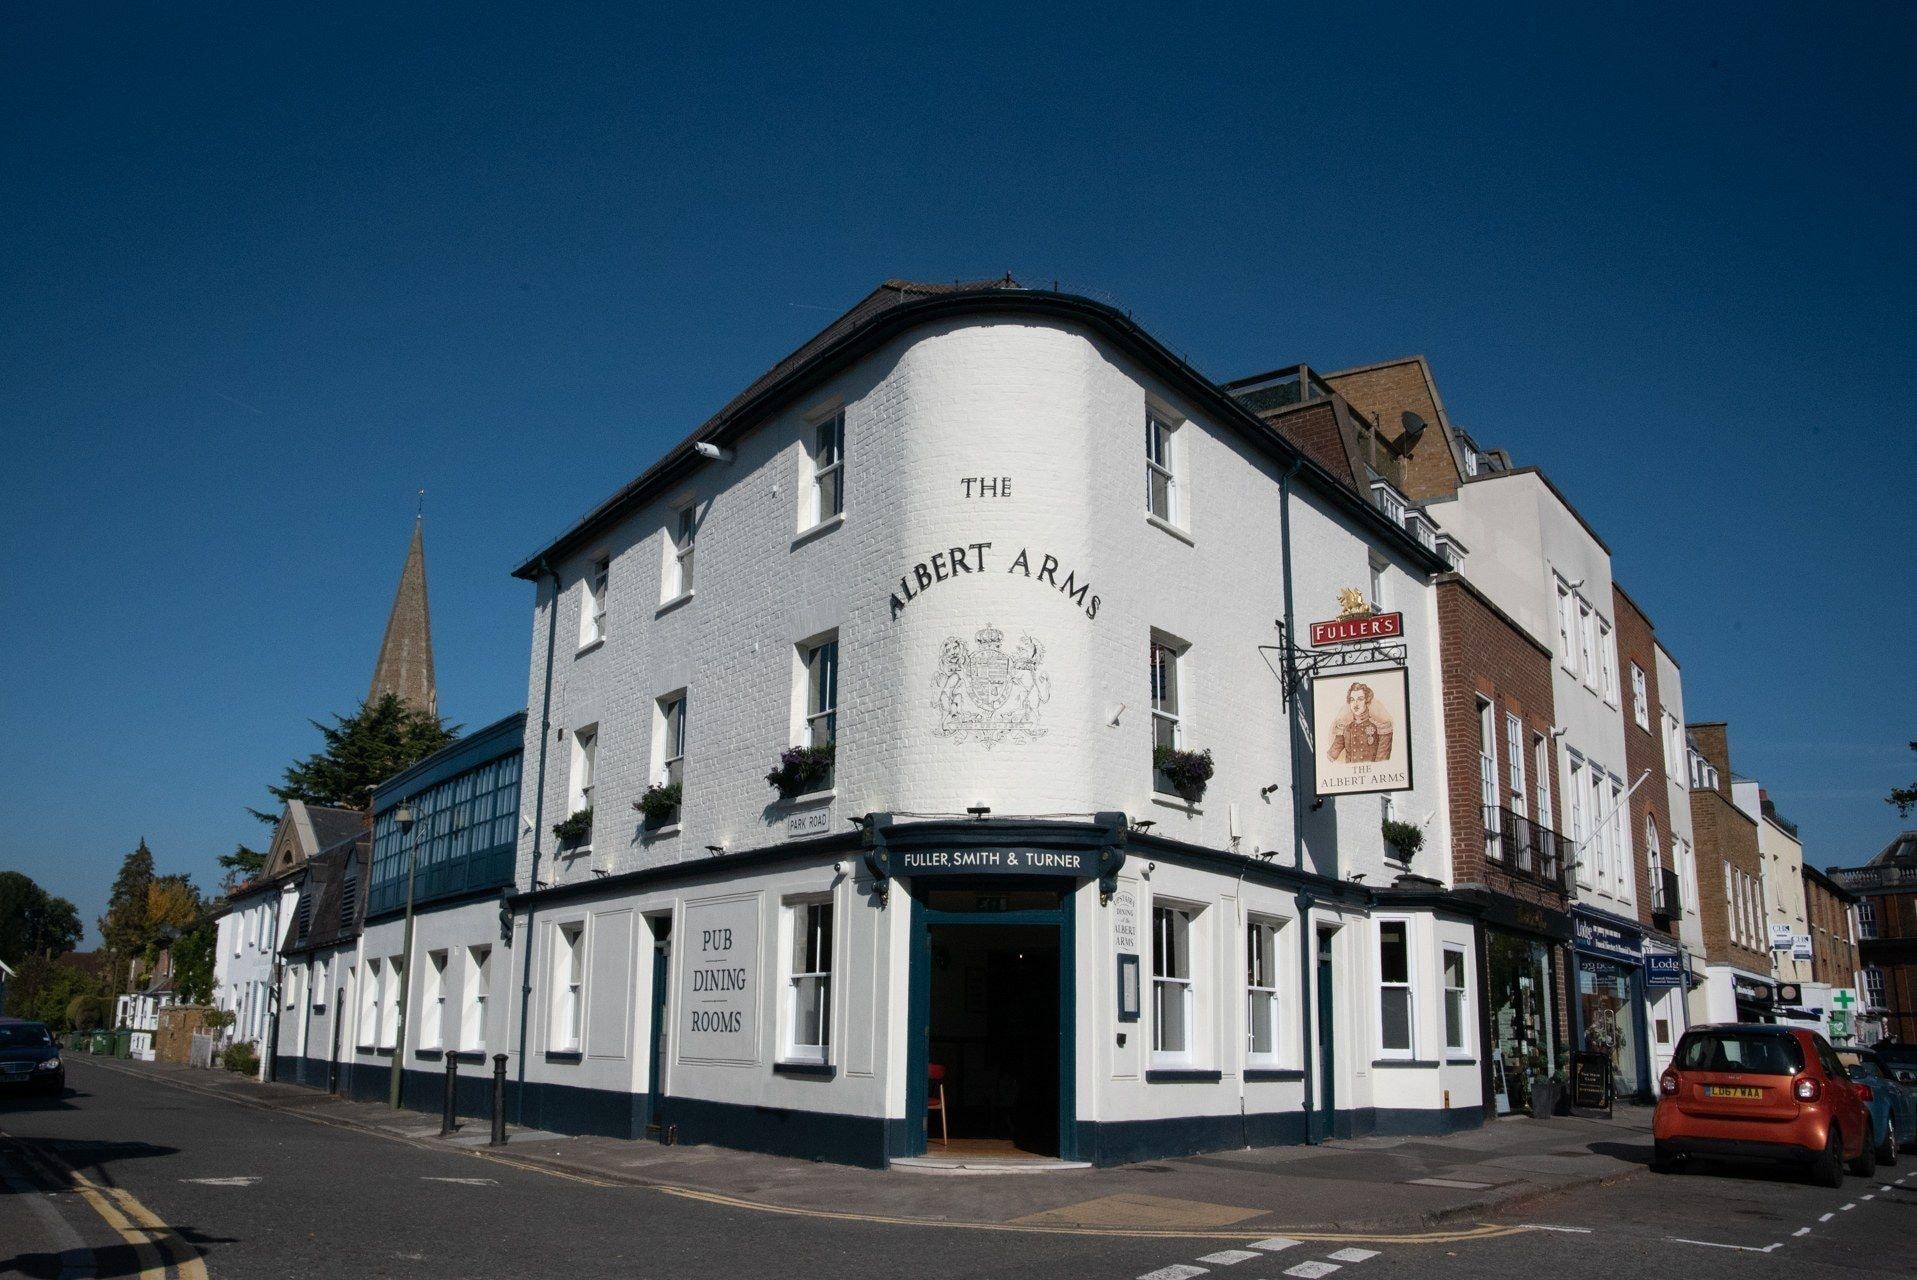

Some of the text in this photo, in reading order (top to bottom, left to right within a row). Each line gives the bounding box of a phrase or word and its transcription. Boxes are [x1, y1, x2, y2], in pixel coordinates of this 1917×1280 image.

[960, 477, 1012, 498] THE
[889, 542, 1101, 622] ALBERT ARMS
[1316, 619, 1394, 640] FULLER'S
[1352, 765, 1372, 774] THE
[1321, 773, 1405, 788] ALBERT ARMS
[790, 814, 827, 829] PARK ROAD
[904, 852, 1081, 868] FULLER, SMITH & TURNER
[1114, 925, 1135, 935] ALBERT
[702, 928, 732, 951] PUB
[1115, 936, 1134, 947] ARMS
[1651, 957, 1680, 972] Lodg
[693, 968, 746, 991] DINING
[691, 1011, 742, 1033] ROOMS
